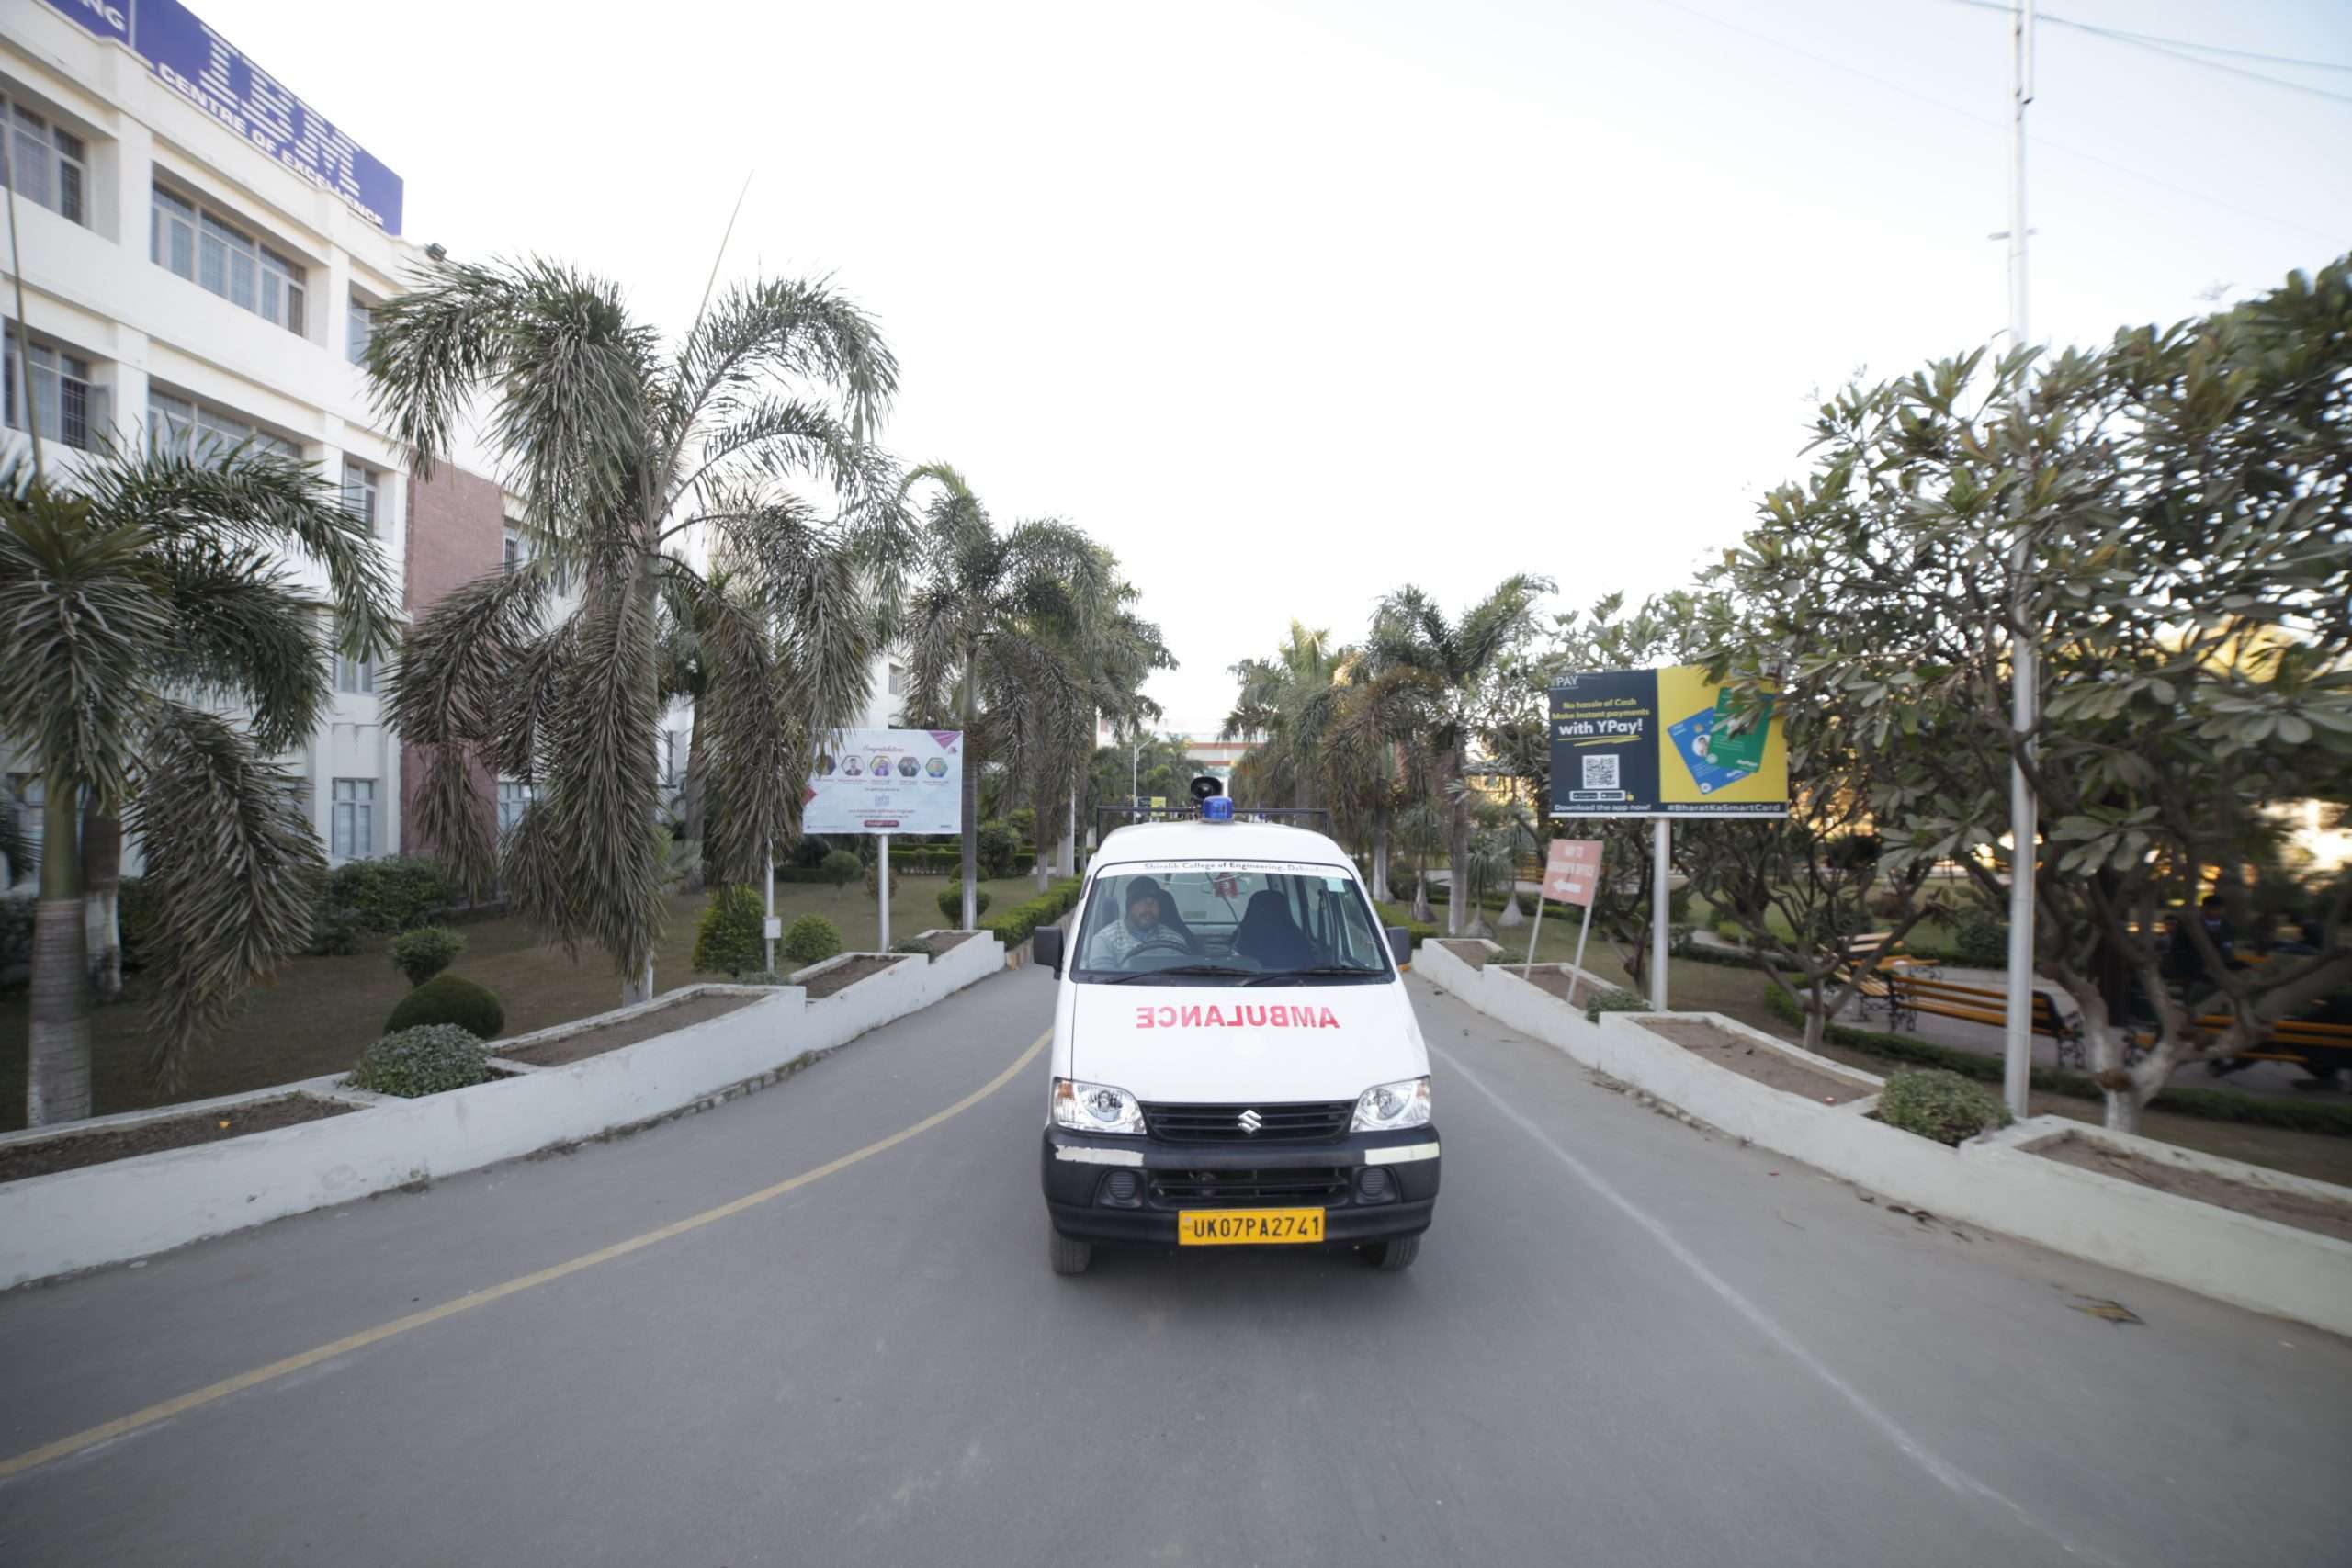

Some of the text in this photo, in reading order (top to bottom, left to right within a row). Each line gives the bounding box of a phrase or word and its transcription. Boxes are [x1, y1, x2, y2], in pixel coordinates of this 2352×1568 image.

[158, 62, 247, 136] CENTRE
[251, 129, 277, 153] OF
[199, 23, 361, 197] IBM
[1603, 699, 1613, 707] of
[1614, 698, 1637, 706] Cash
[1606, 708, 1651, 719] payments
[1558, 718, 1644, 735] with YPay!
[1182, 862, 1215, 870] College
[1194, 1216, 1319, 1237] UK07PA2741
